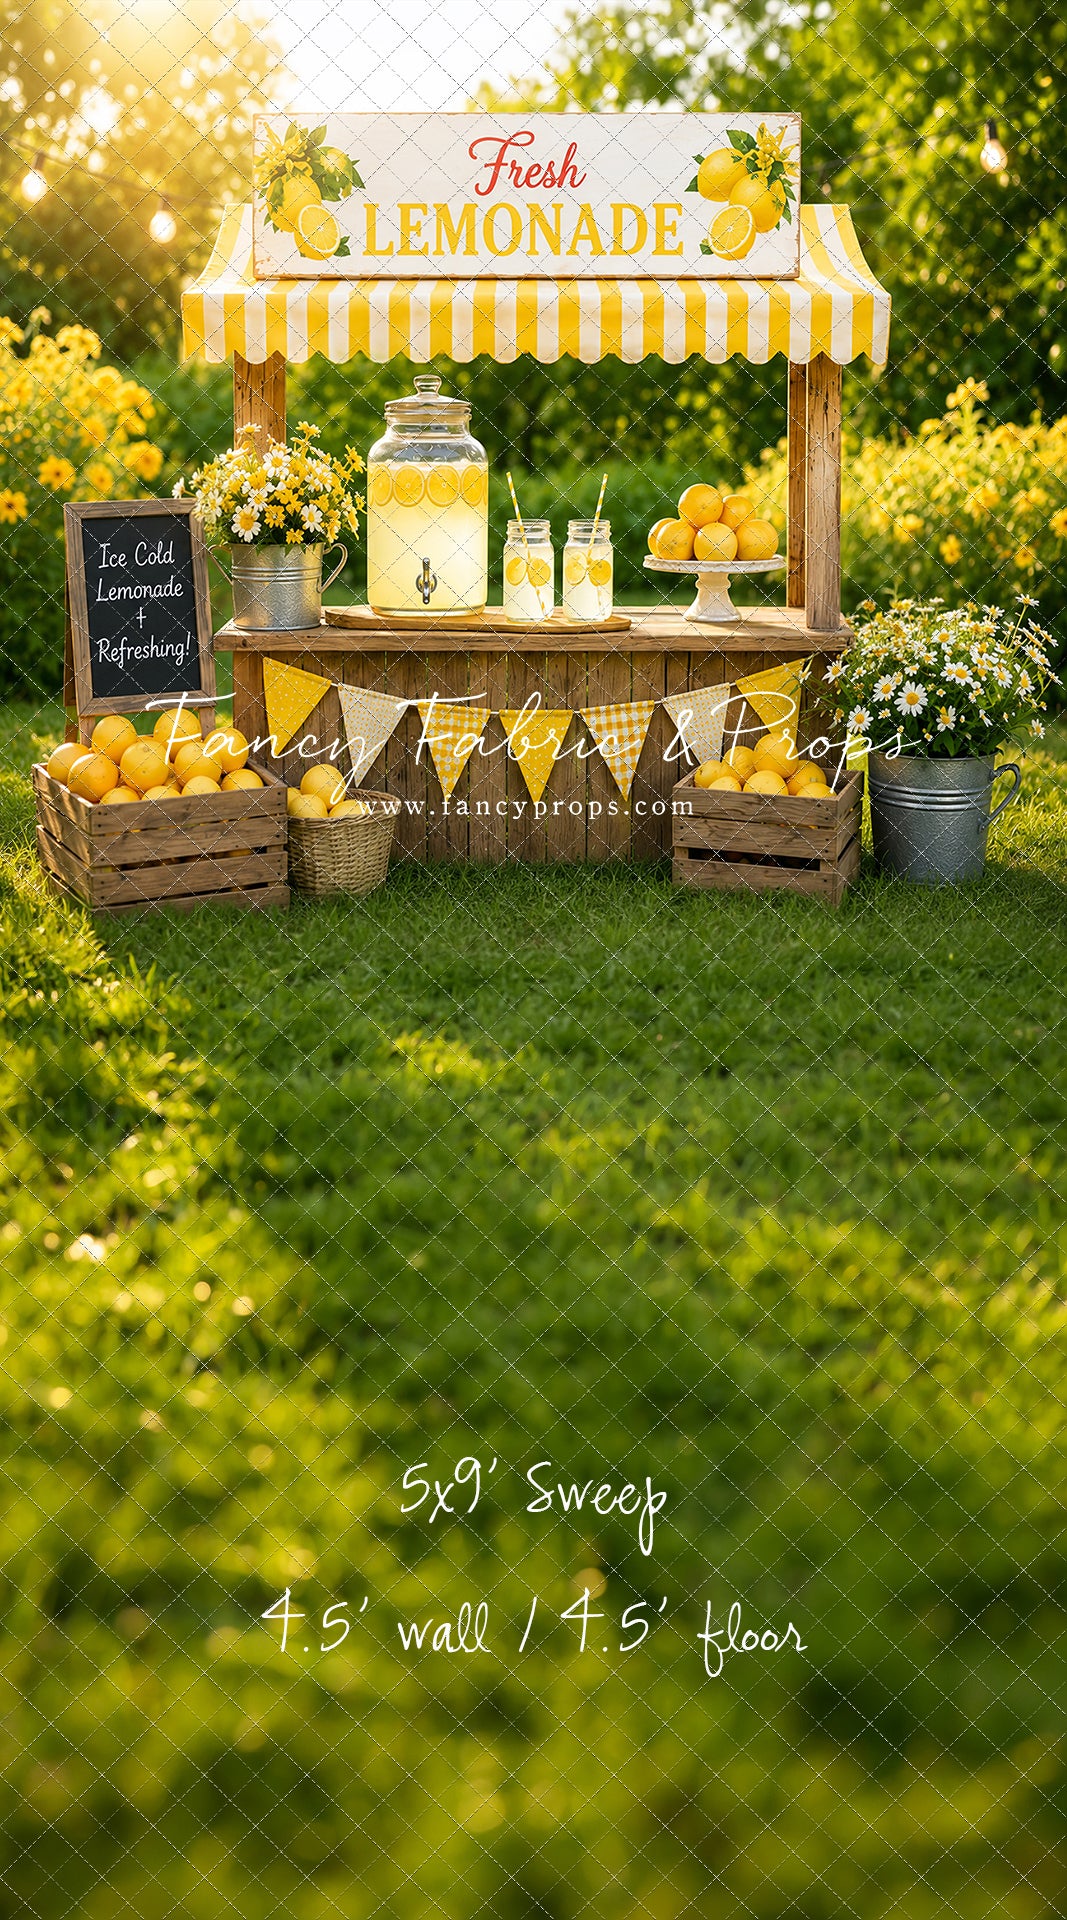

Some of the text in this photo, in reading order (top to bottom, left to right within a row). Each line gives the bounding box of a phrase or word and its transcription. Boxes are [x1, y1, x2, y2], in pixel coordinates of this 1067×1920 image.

[468, 130, 587, 196] Fresh
[362, 202, 684, 257] LEMONADE
[98, 540, 175, 569] Ice Cold
[96, 575, 184, 602] Lemonade
[96, 631, 191, 669] Refreshing!
